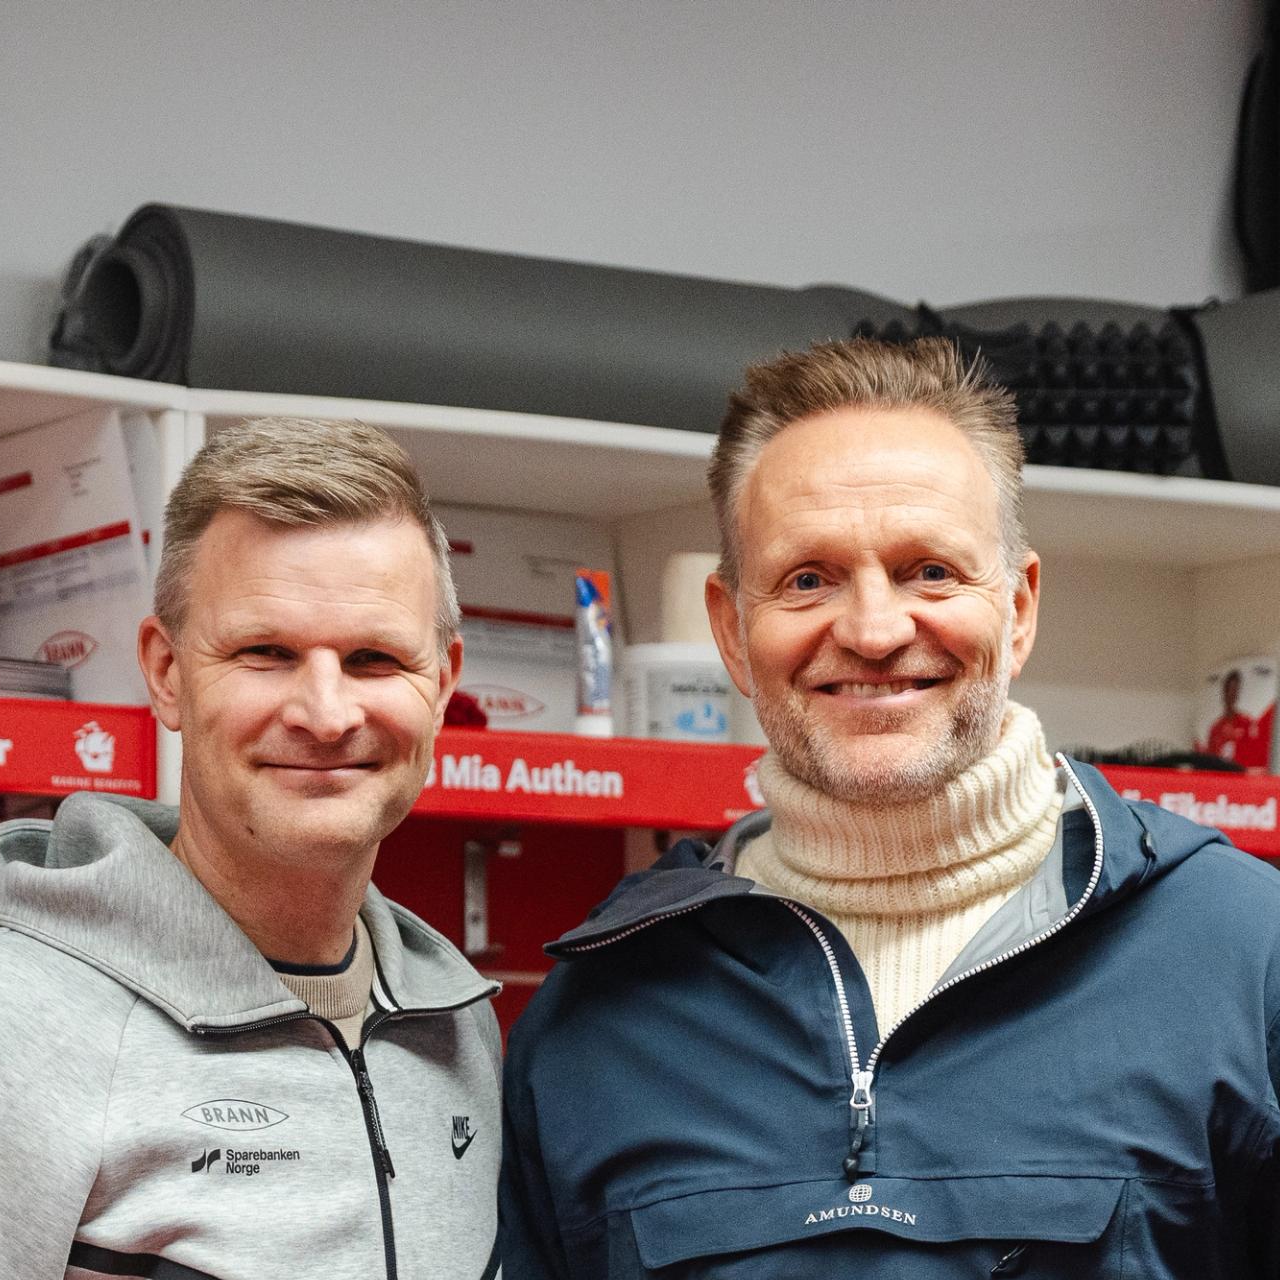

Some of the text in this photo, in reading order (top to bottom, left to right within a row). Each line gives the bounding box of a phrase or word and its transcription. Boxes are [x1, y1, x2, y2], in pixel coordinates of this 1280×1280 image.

[441, 755, 502, 791] Mia
[506, 758, 623, 797] Authen
[201, 1107, 270, 1124] BRANN
[452, 1115, 470, 1139] NIKE
[226, 1149, 300, 1163] Sparebanken
[226, 1161, 261, 1176] Norge
[805, 1205, 916, 1225] AMUNDSEN
